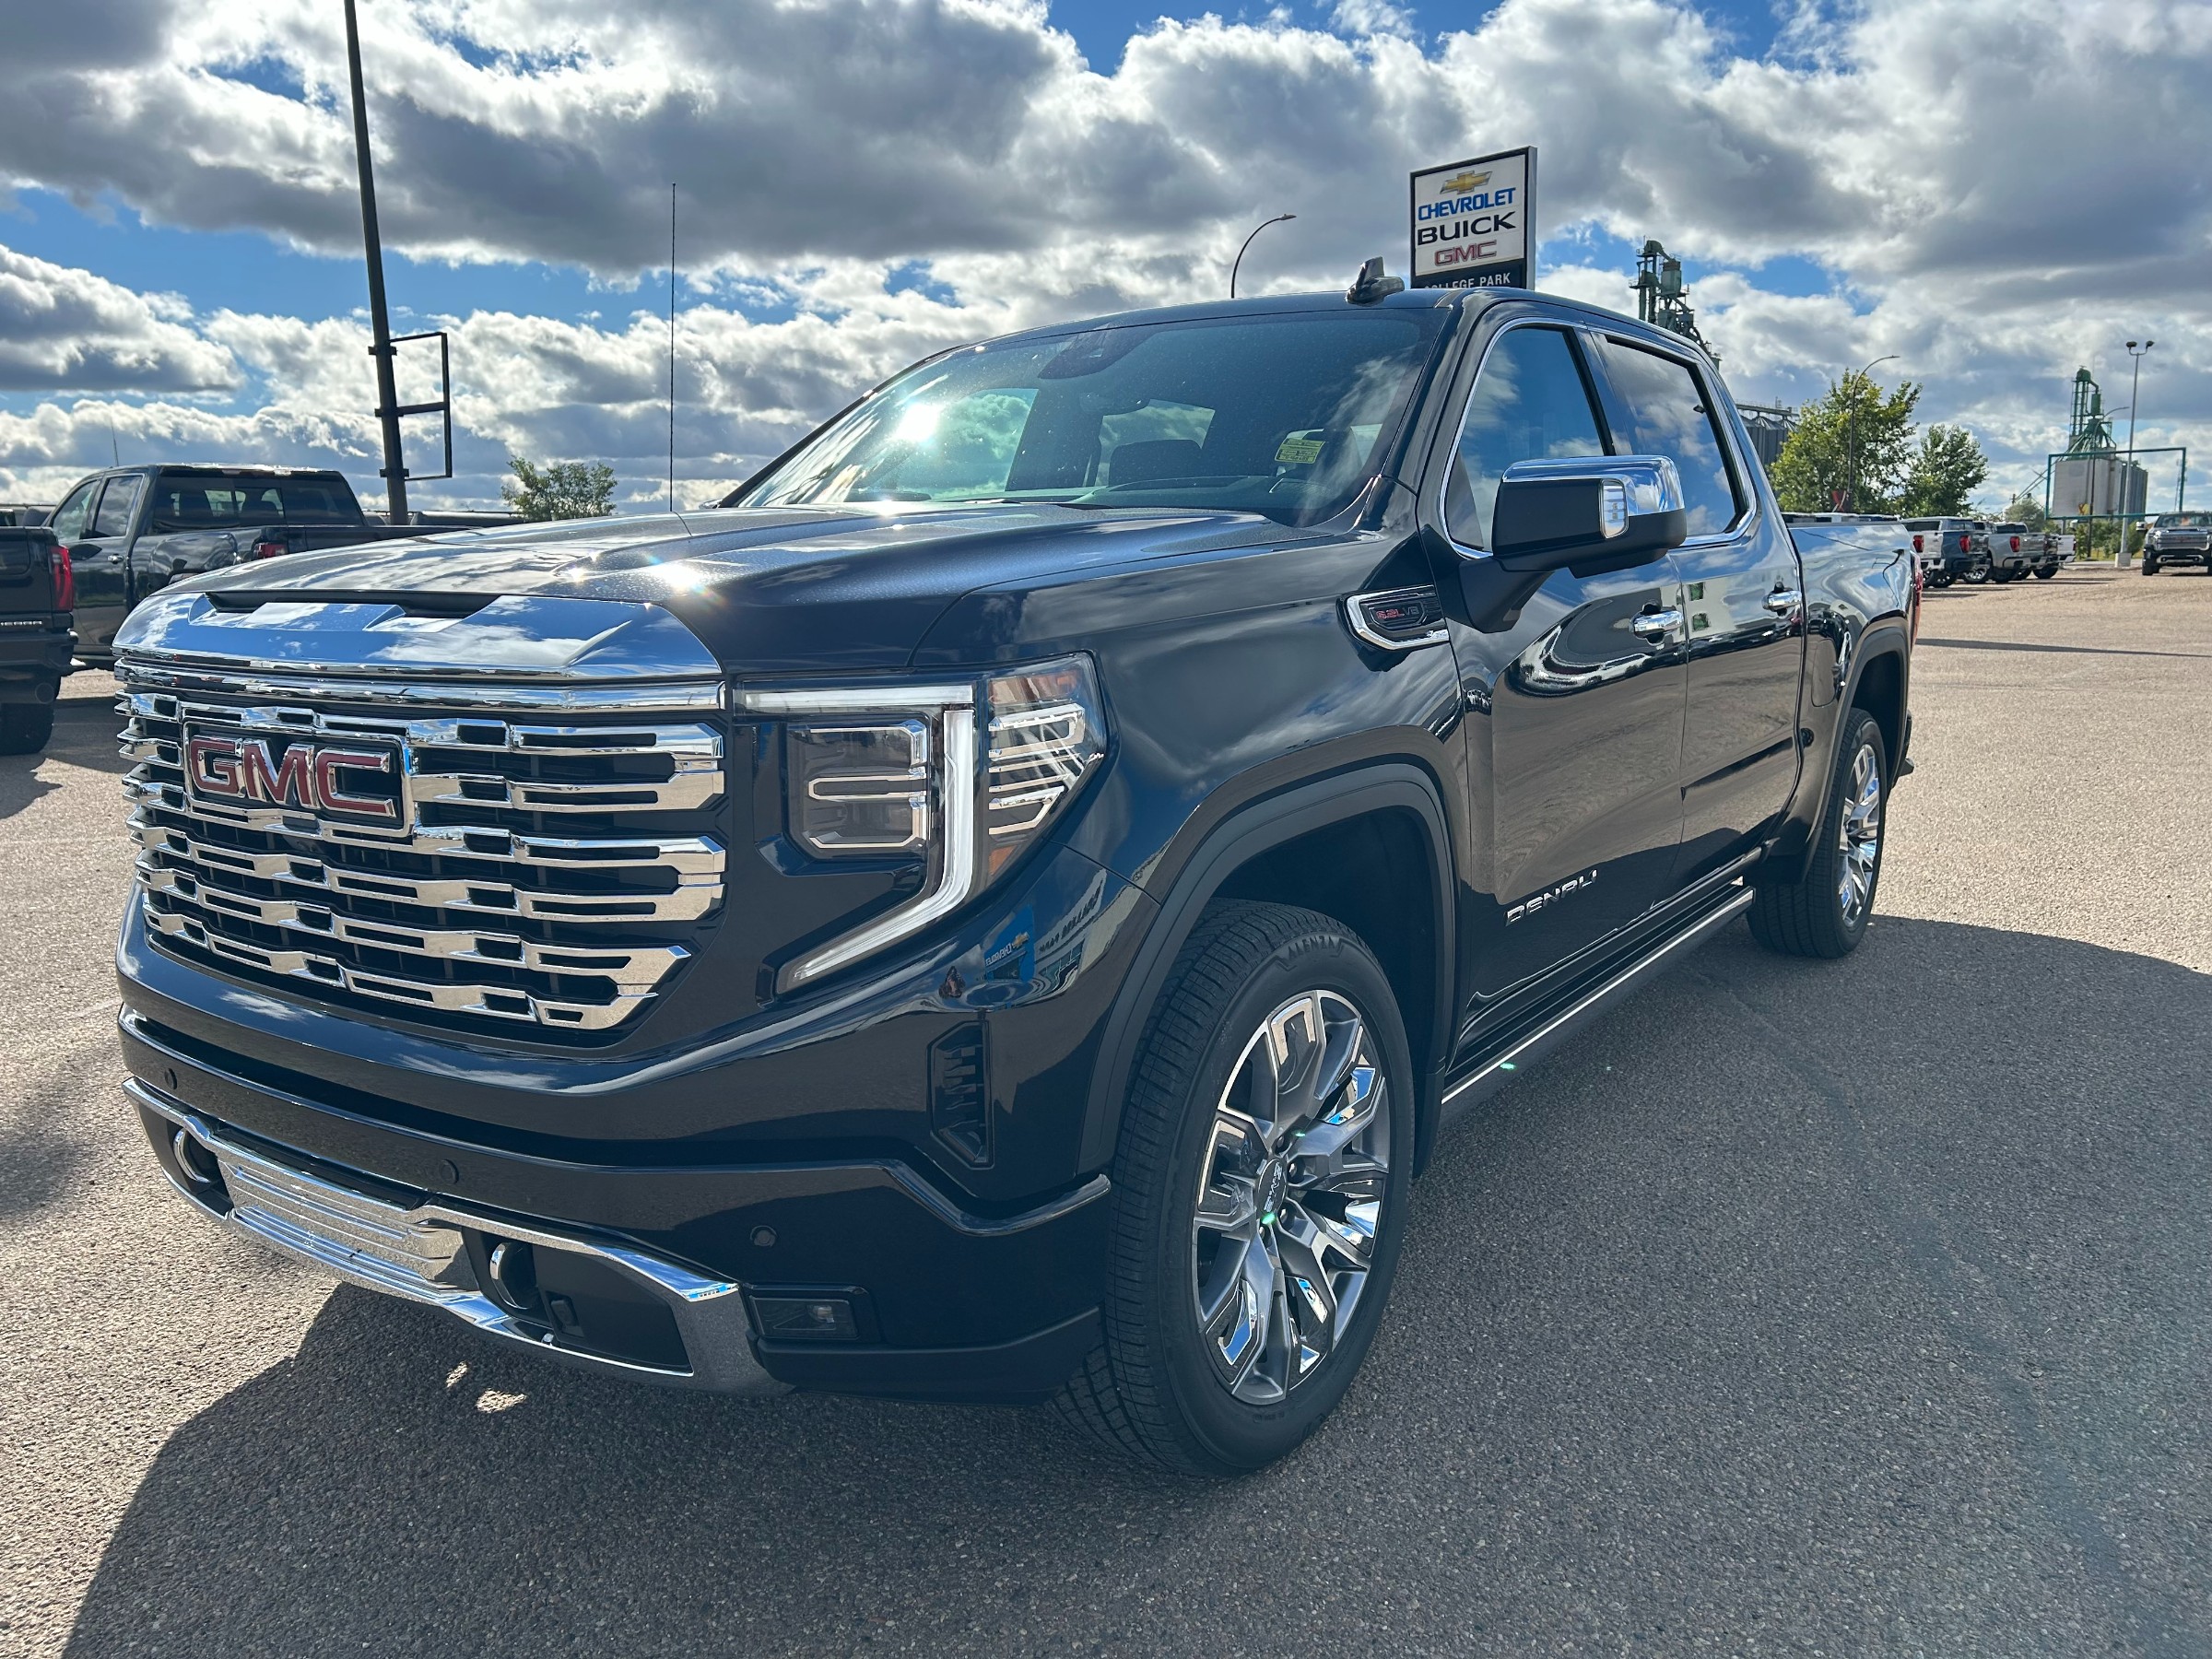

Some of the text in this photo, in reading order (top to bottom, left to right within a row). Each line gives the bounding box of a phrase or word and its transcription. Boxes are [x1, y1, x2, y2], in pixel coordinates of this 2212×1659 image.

[1418, 187, 1516, 221] CHEVROLET
[1418, 211, 1516, 246] BUICK
[1435, 240, 1497, 266] GMC
[1479, 272, 1511, 287] PARK
[189, 735, 396, 818] GMC
[1504, 869, 1598, 927] DENALI
[1288, 935, 1335, 960] ALENZA
